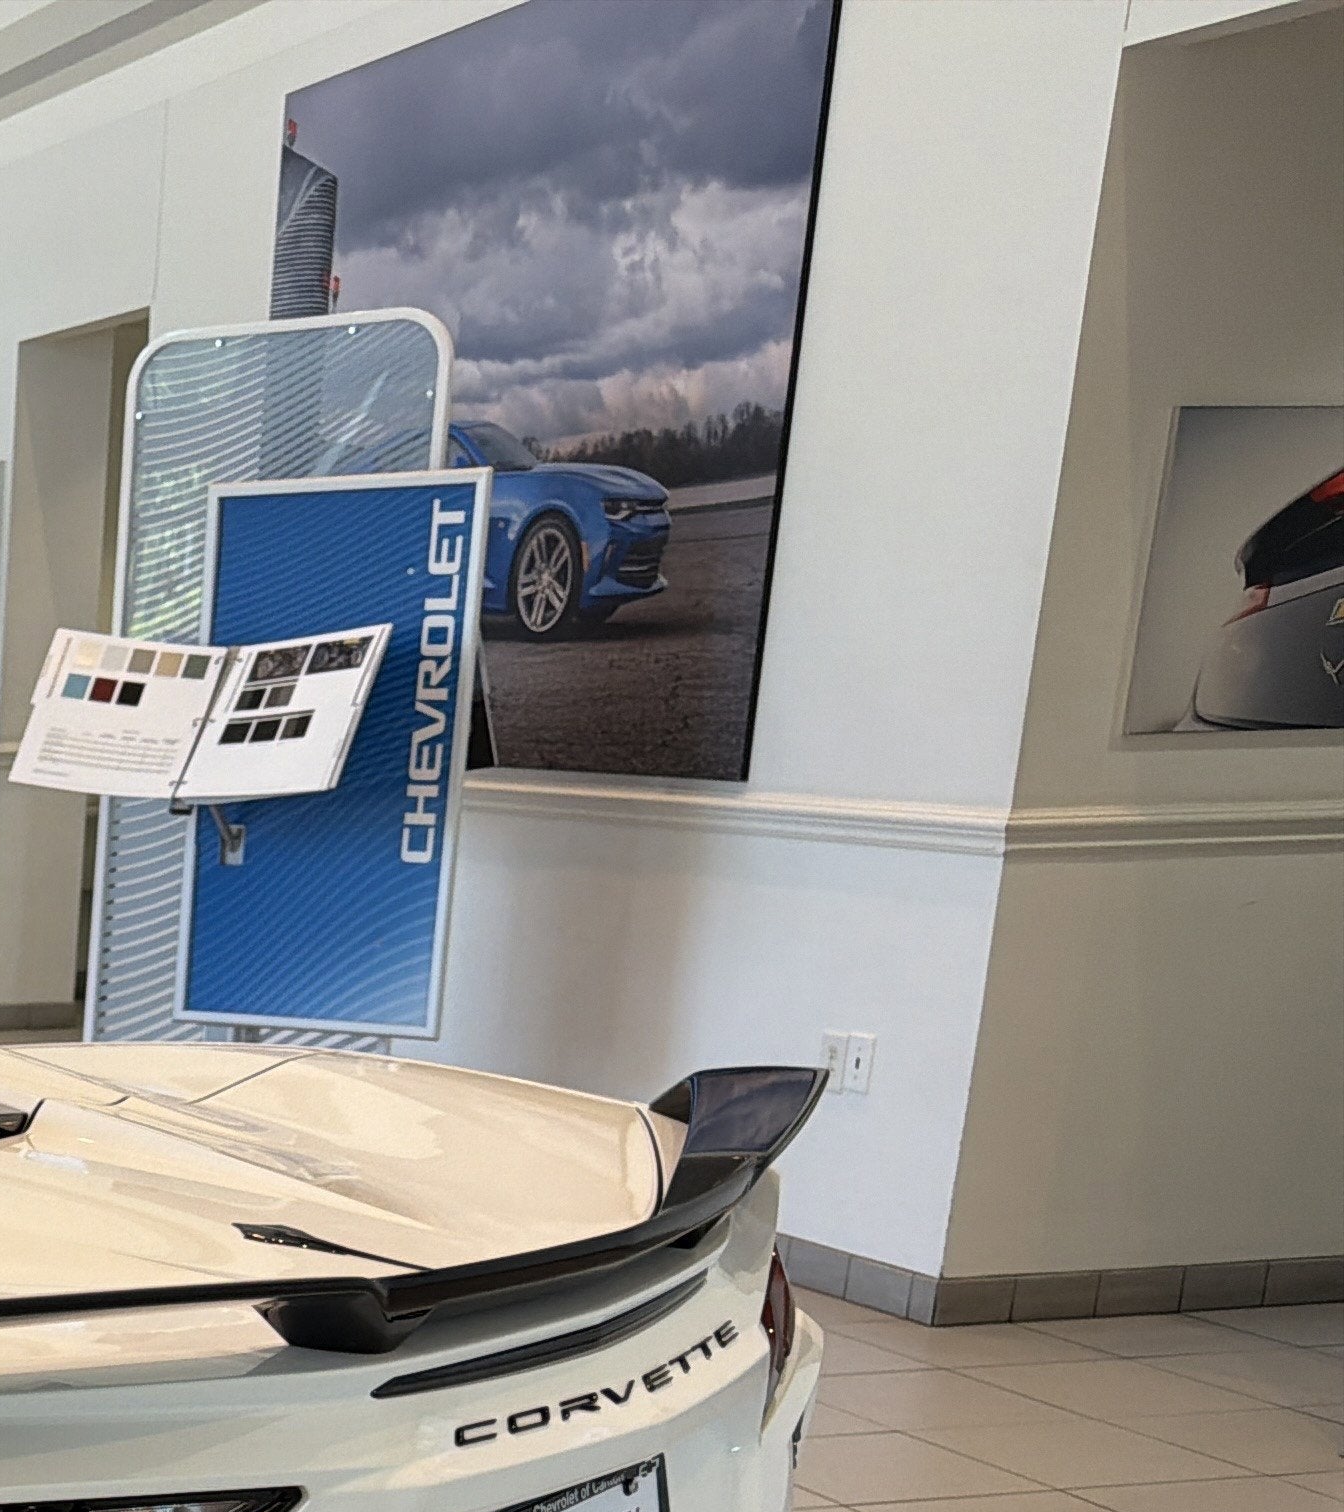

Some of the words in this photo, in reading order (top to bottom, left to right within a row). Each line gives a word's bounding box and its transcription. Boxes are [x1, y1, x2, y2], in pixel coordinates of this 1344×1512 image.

[400, 498, 466, 865] CHEVROLET
[454, 1319, 740, 1447] CORVETTE
[580, 1483, 592, 1500] of
